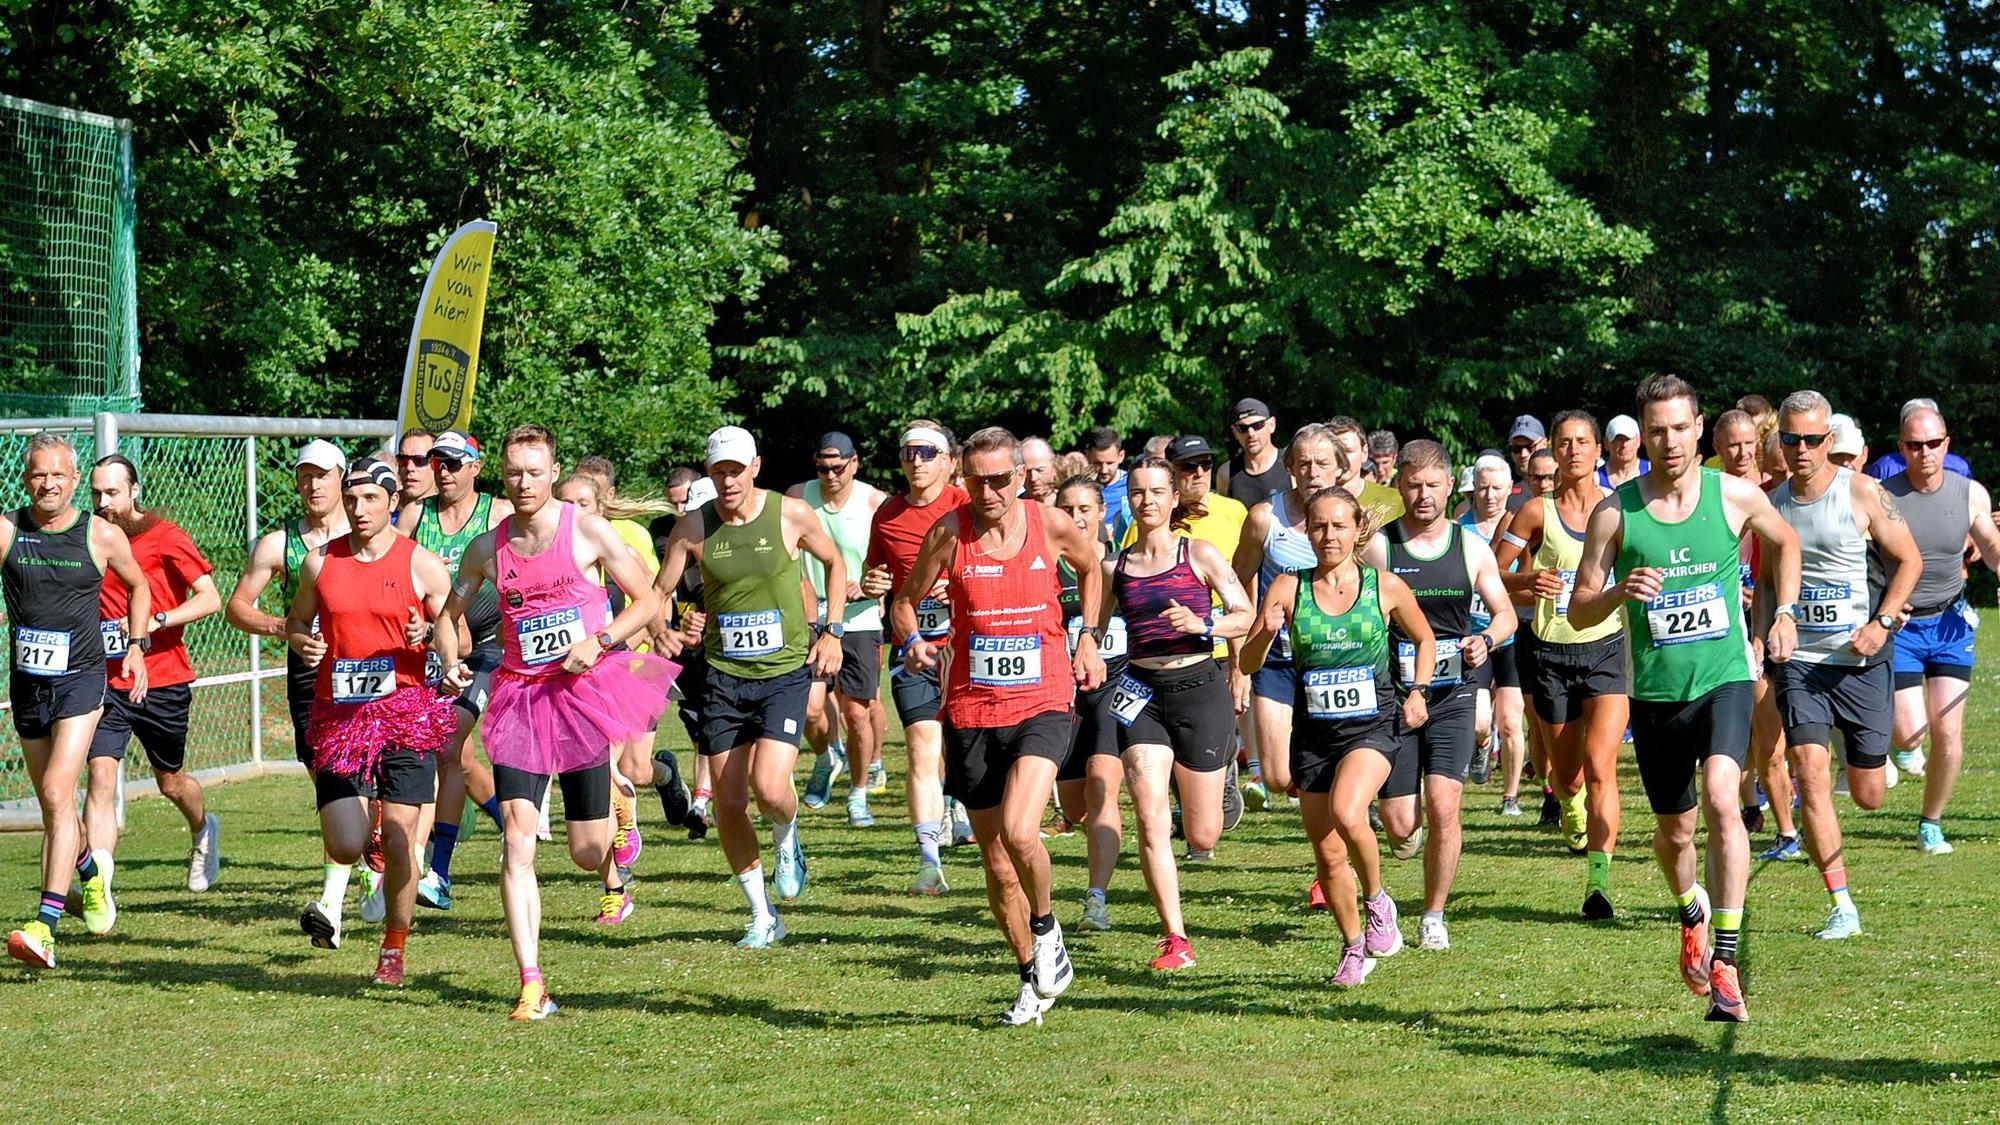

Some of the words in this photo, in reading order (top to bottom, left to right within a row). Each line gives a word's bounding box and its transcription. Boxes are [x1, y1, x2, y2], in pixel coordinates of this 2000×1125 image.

[454, 253, 482, 273] Wir
[447, 279, 472, 297] von
[434, 296, 469, 324] hier!
[431, 343, 445, 354] 1924
[428, 363, 452, 393] TuS
[18, 557, 28, 565] LC
[31, 557, 82, 568] Euskirchen
[1669, 547, 1691, 564] LC
[1662, 562, 1717, 579] SKIRCHEN
[1061, 594, 1074, 603] LC
[1412, 588, 1464, 597] Euskirchen
[1653, 588, 1718, 609] PETERS
[1801, 587, 1846, 599] ETERS
[920, 599, 943, 609] ERS
[522, 609, 576, 632] PETERS
[724, 612, 776, 628] PETERS
[917, 613, 937, 629] 78
[1665, 608, 1712, 635] 224
[1802, 604, 1838, 623] 195
[533, 629, 572, 655] 220
[733, 630, 768, 648] 218
[975, 636, 1036, 650] PETERS
[1326, 628, 1347, 641] LC
[108, 636, 128, 651] 21
[1311, 641, 1363, 651] EUSKIRCHEN
[22, 646, 55, 666] 217
[336, 659, 389, 671] PETERS
[984, 656, 1026, 676] 189
[346, 676, 382, 694] 172
[1308, 669, 1368, 686] PETERS
[1120, 675, 1151, 698] TERS
[1112, 691, 1134, 712] 97
[1320, 688, 1360, 709] 169
